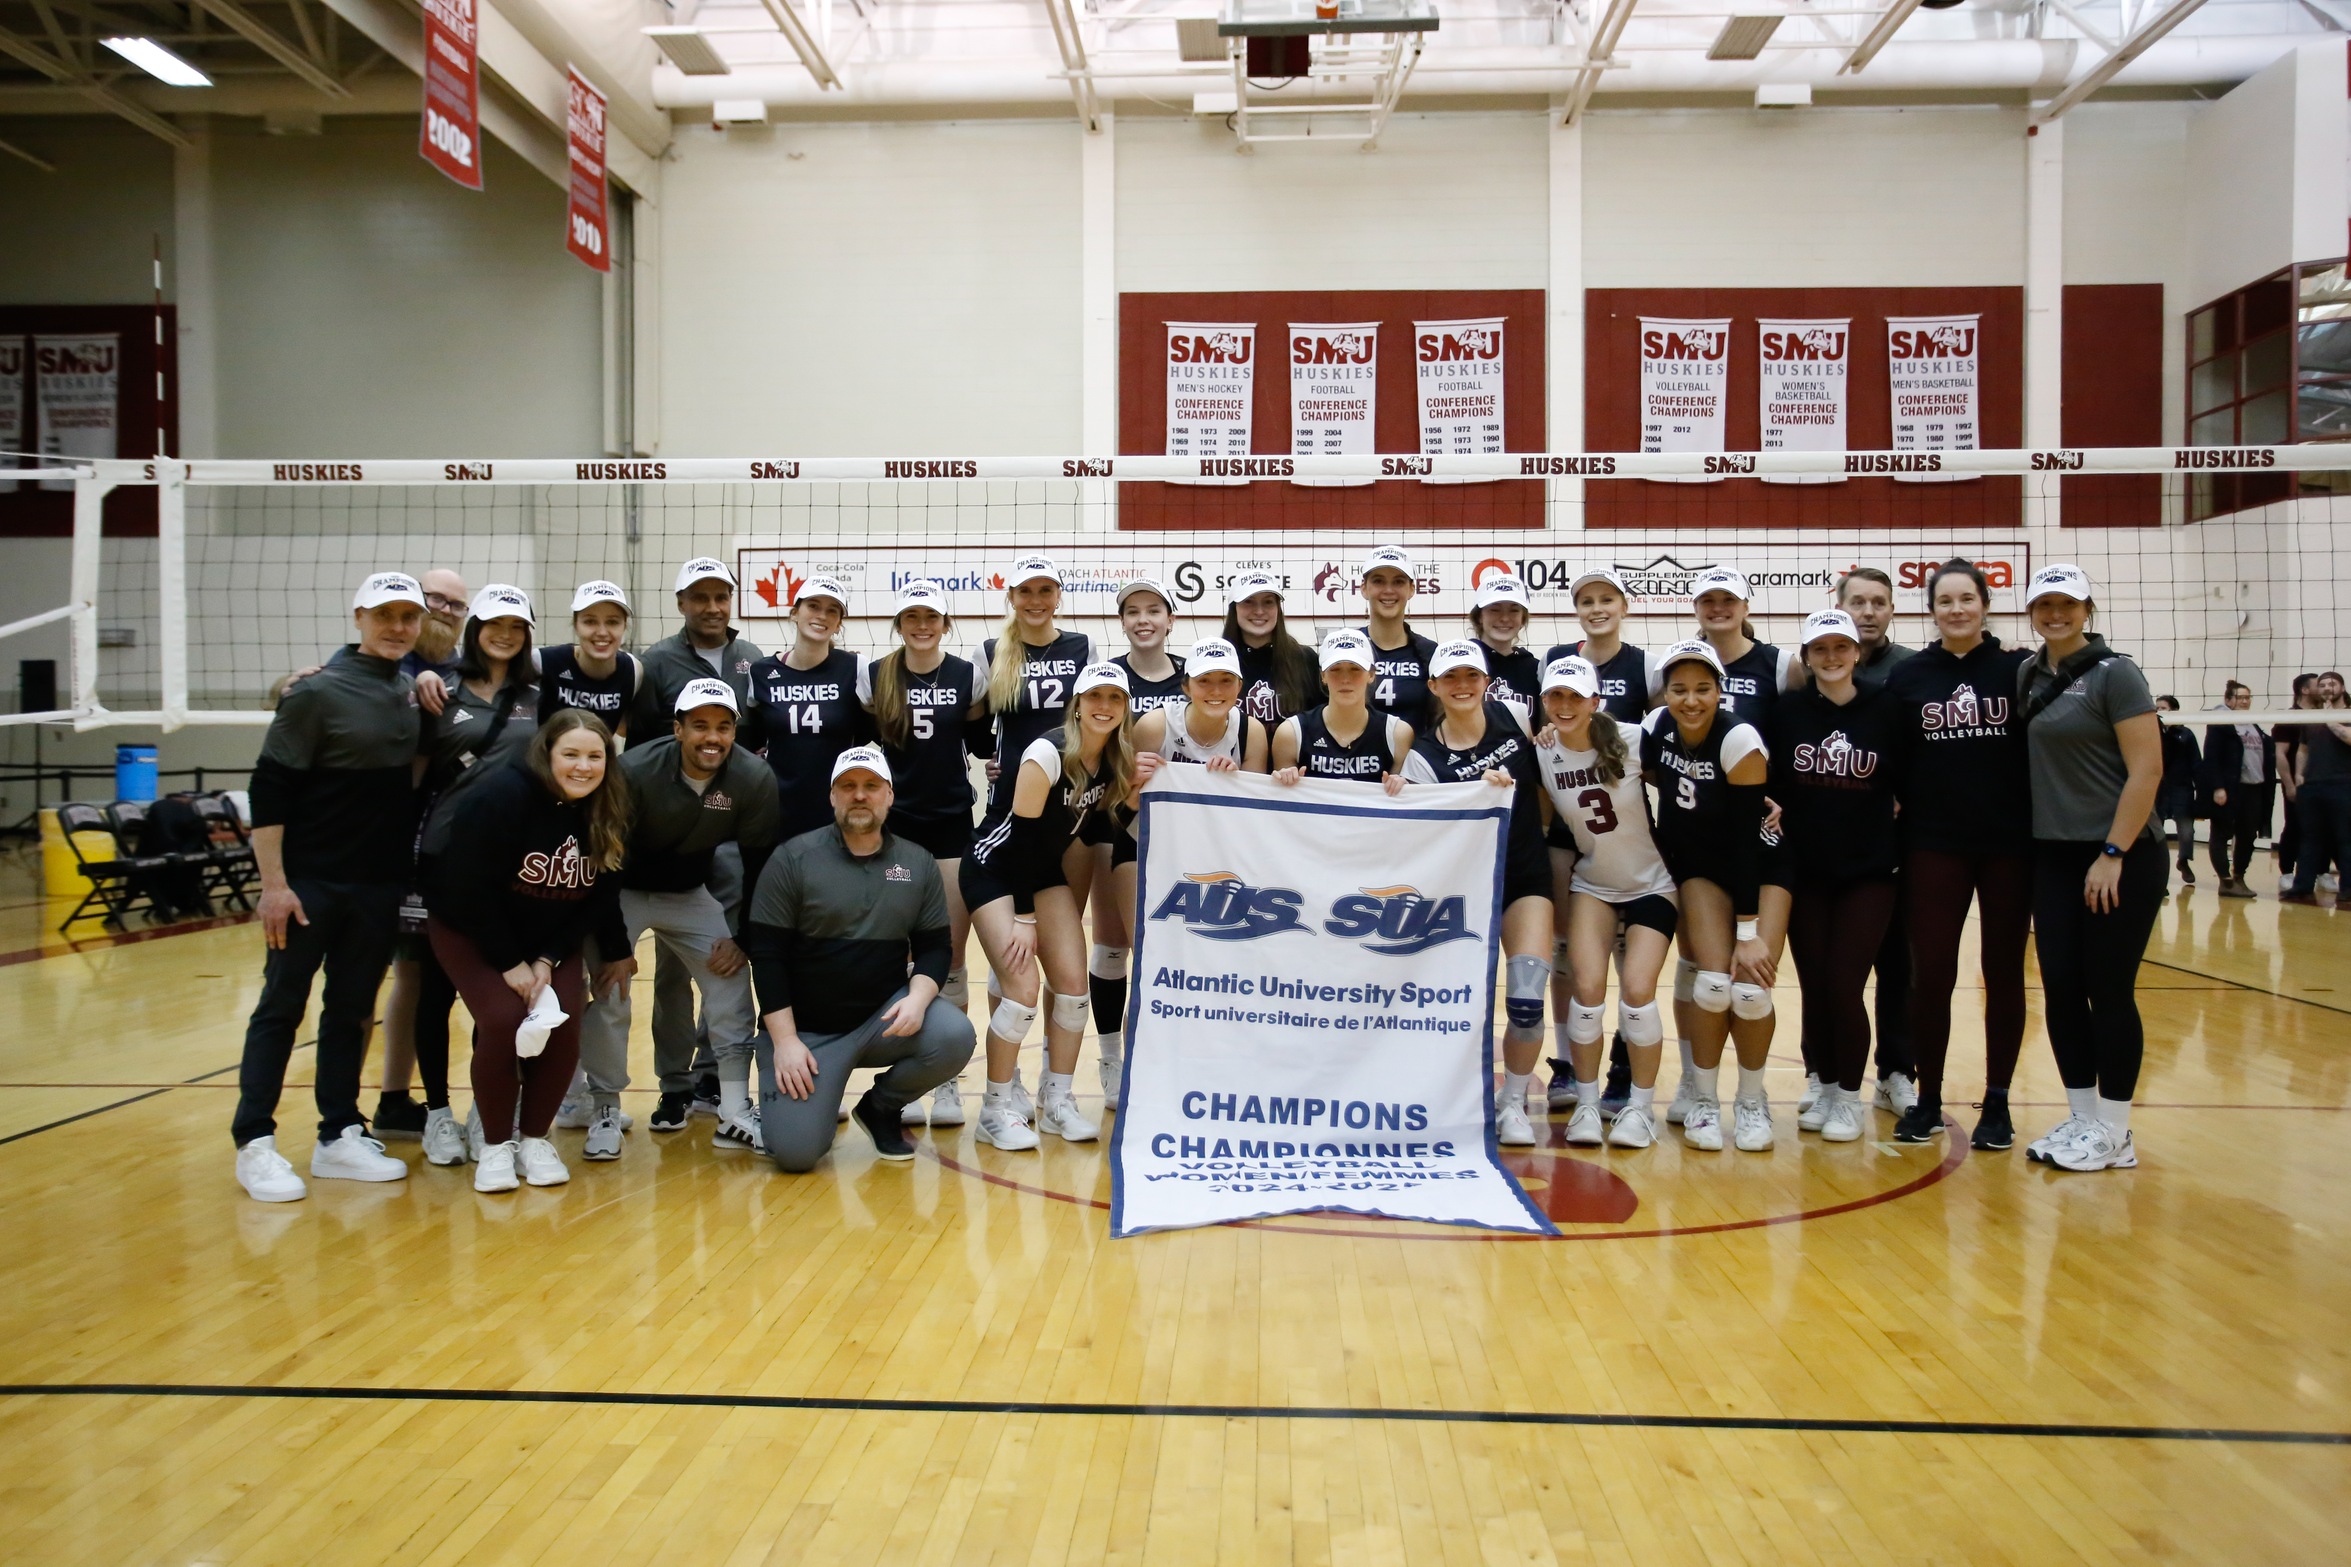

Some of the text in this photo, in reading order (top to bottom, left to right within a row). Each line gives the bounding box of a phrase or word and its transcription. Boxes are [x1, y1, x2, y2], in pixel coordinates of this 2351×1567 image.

[1171, 334, 1251, 364] SMU
[1293, 334, 1374, 364] SMU
[1418, 330, 1500, 362] SMU
[1644, 330, 1726, 361] SMU
[1763, 330, 1846, 361] SMU
[1891, 327, 1974, 359] SMU
[1170, 366, 1250, 378] HUSKIES
[1294, 366, 1373, 380] HUSKIES
[1420, 362, 1500, 377] HUSKIES
[1644, 362, 1724, 375] HUSKIES
[1764, 364, 1844, 376] HUSKIES
[1892, 360, 1974, 374] HUSKIES
[1177, 384, 1243, 393] MEN'S HOCKEY
[1311, 386, 1355, 394] FOOTBALL
[1438, 381, 1483, 391] FOOTBALL
[1656, 381, 1710, 391] VOLLEYBALL
[1782, 382, 1825, 390] WOMEN'S
[1892, 378, 1974, 389] MEN'S BASKETBALL
[1175, 398, 1244, 409] CONFERENCE
[1426, 395, 1496, 408] CONFERENCE
[1648, 395, 1717, 406] CONFERENCE
[1775, 392, 1831, 400] BASKETBALL
[1898, 394, 1969, 406] CONFERENCE
[1299, 400, 1368, 410] CONFERENCE
[1429, 406, 1494, 419] CHAMPIONS
[1650, 406, 1714, 417] CHAMPIONS
[1769, 403, 1837, 414] CONFERENCE
[1900, 405, 1966, 417] CHAMPIONS
[1177, 410, 1241, 420] CHAMPIONS
[1301, 410, 1365, 421] CHAMPIONS
[1771, 415, 1834, 425] CHAMPIONS
[1381, 456, 1433, 476] SMU
[1520, 456, 1616, 475] HUSKIES
[1703, 454, 1756, 474] SMU
[1844, 455, 1942, 473] HUSKIES
[2030, 451, 2084, 470] SMU
[2174, 449, 2275, 469] HUSKIES
[273, 464, 363, 480] HUSKIES
[444, 463, 493, 481] SMU
[576, 462, 667, 480] HUSKIES
[750, 460, 800, 480] SMU
[884, 460, 978, 478] HUSKIES
[1062, 458, 1113, 478] SMU
[1200, 458, 1295, 477] HUSKIES
[688, 560, 723, 574] CHAMPIONS
[1060, 569, 1146, 578] OACH ATLANTIC
[1416, 564, 1440, 574] THE
[1700, 569, 1738, 581] CHAMPIONS
[1749, 570, 1832, 586] aramark
[2035, 571, 2077, 585] CHAMPIONS
[1810, 613, 1848, 625] CHAMPIONS
[1328, 636, 1364, 648] CHAMPIONS
[1197, 644, 1232, 656] CHAMPIONS
[1440, 646, 1477, 658] CHAMPIONS
[1020, 659, 1076, 678] USKIES
[1088, 665, 1124, 677] CHAMPIONS
[1375, 662, 1420, 677] SKIES
[1550, 664, 1586, 675] CHAMPIONS
[692, 682, 730, 695] CHAMPIONS
[770, 683, 839, 703] HUSKIES
[1027, 678, 1065, 710] 12
[1375, 678, 1396, 706] 4
[558, 686, 621, 711] HUSKIES
[788, 704, 823, 734] 14
[1921, 697, 2008, 730] SMU
[913, 708, 934, 739] 5
[1924, 728, 2007, 741] VOLLEYBALL
[842, 749, 879, 763] CHAMPIONS
[1454, 738, 1519, 781] HUSKIES
[1794, 743, 1877, 778] SMU
[1310, 755, 1380, 774] HUSKIES
[1660, 750, 1714, 779] HUSKIES
[705, 794, 732, 806] SMU
[1676, 777, 1696, 810] 9
[1577, 788, 1618, 835] 3
[518, 852, 598, 888] SMU
[886, 867, 910, 878] SMU
[1149, 875, 1479, 950] AUS SUA
[1152, 966, 1472, 1008] Atlantic University Sport
[1150, 1000, 1471, 1035] Sport universitaire de l'Atlantique
[1182, 1090, 1428, 1131] CHAMPIONS
[1151, 1133, 1455, 1158] CHAMPIONNES
[1179, 1160, 1437, 1169] VOLLEYBALL
